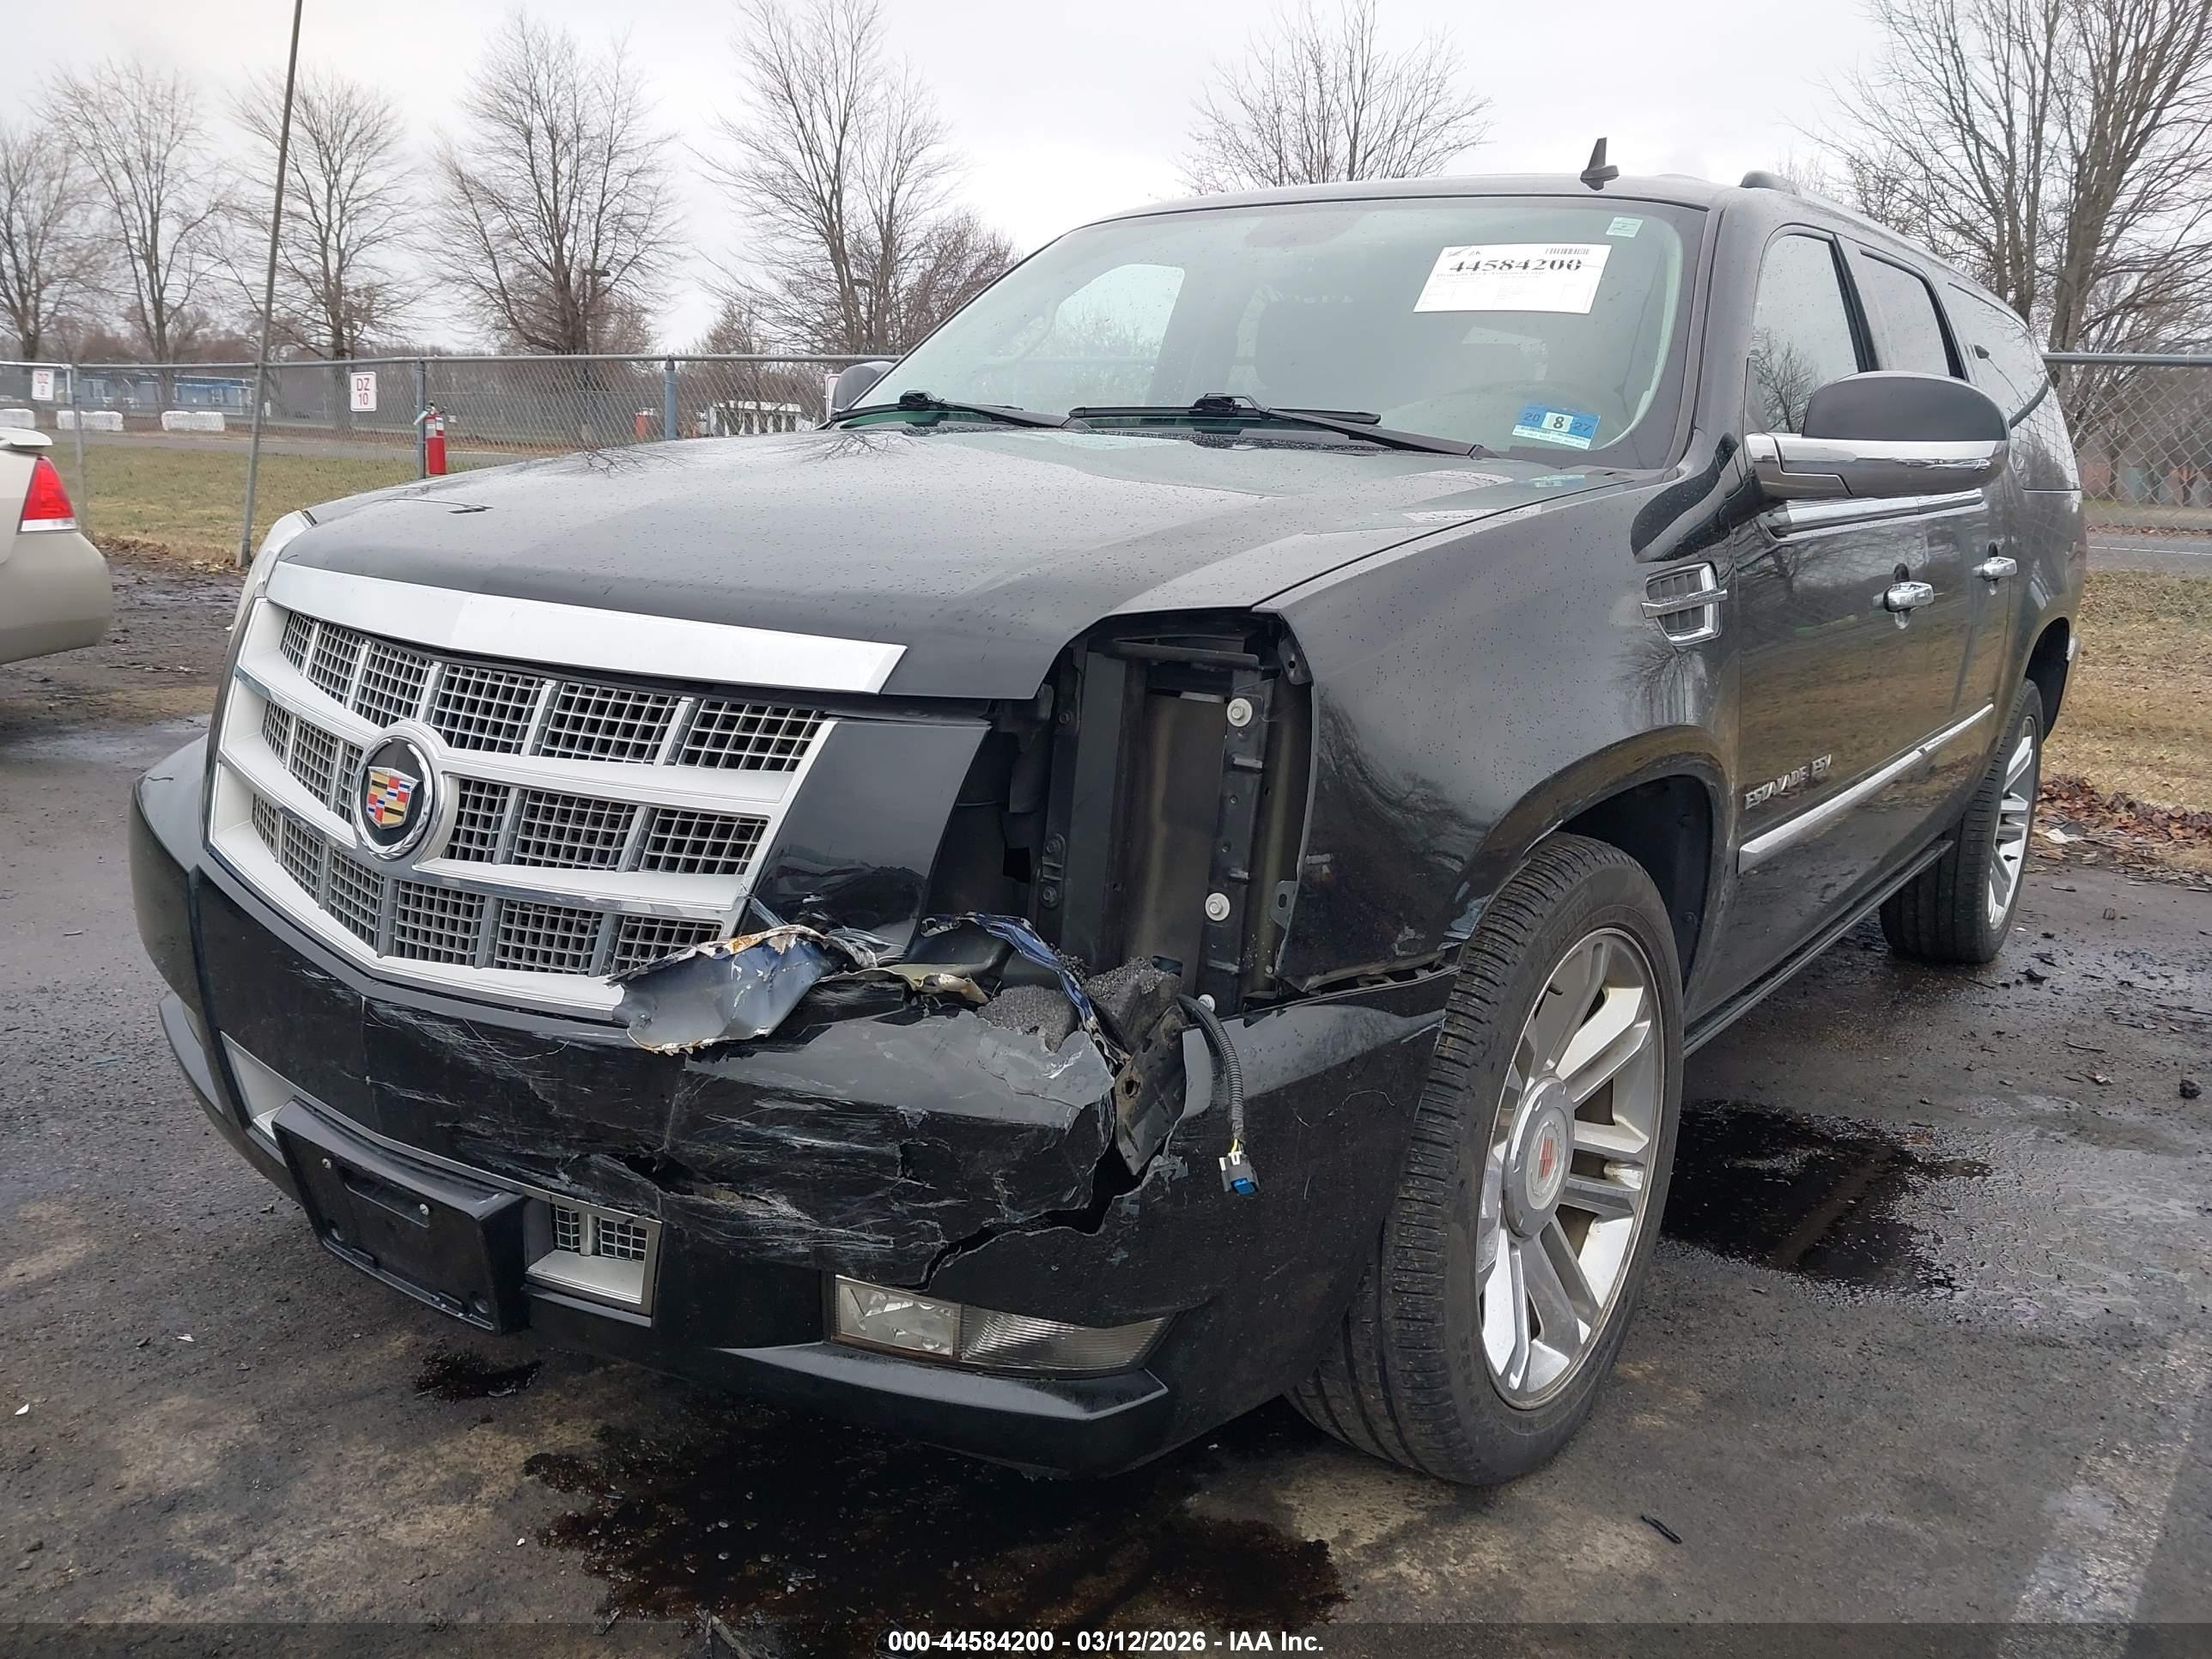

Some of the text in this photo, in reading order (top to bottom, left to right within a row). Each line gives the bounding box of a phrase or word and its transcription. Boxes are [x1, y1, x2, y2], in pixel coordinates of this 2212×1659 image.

[1449, 259, 1582, 272] 44584200
[356, 378, 370, 392] DZ
[358, 392, 369, 406] 10
[1524, 412, 1591, 432] 20 8 27
